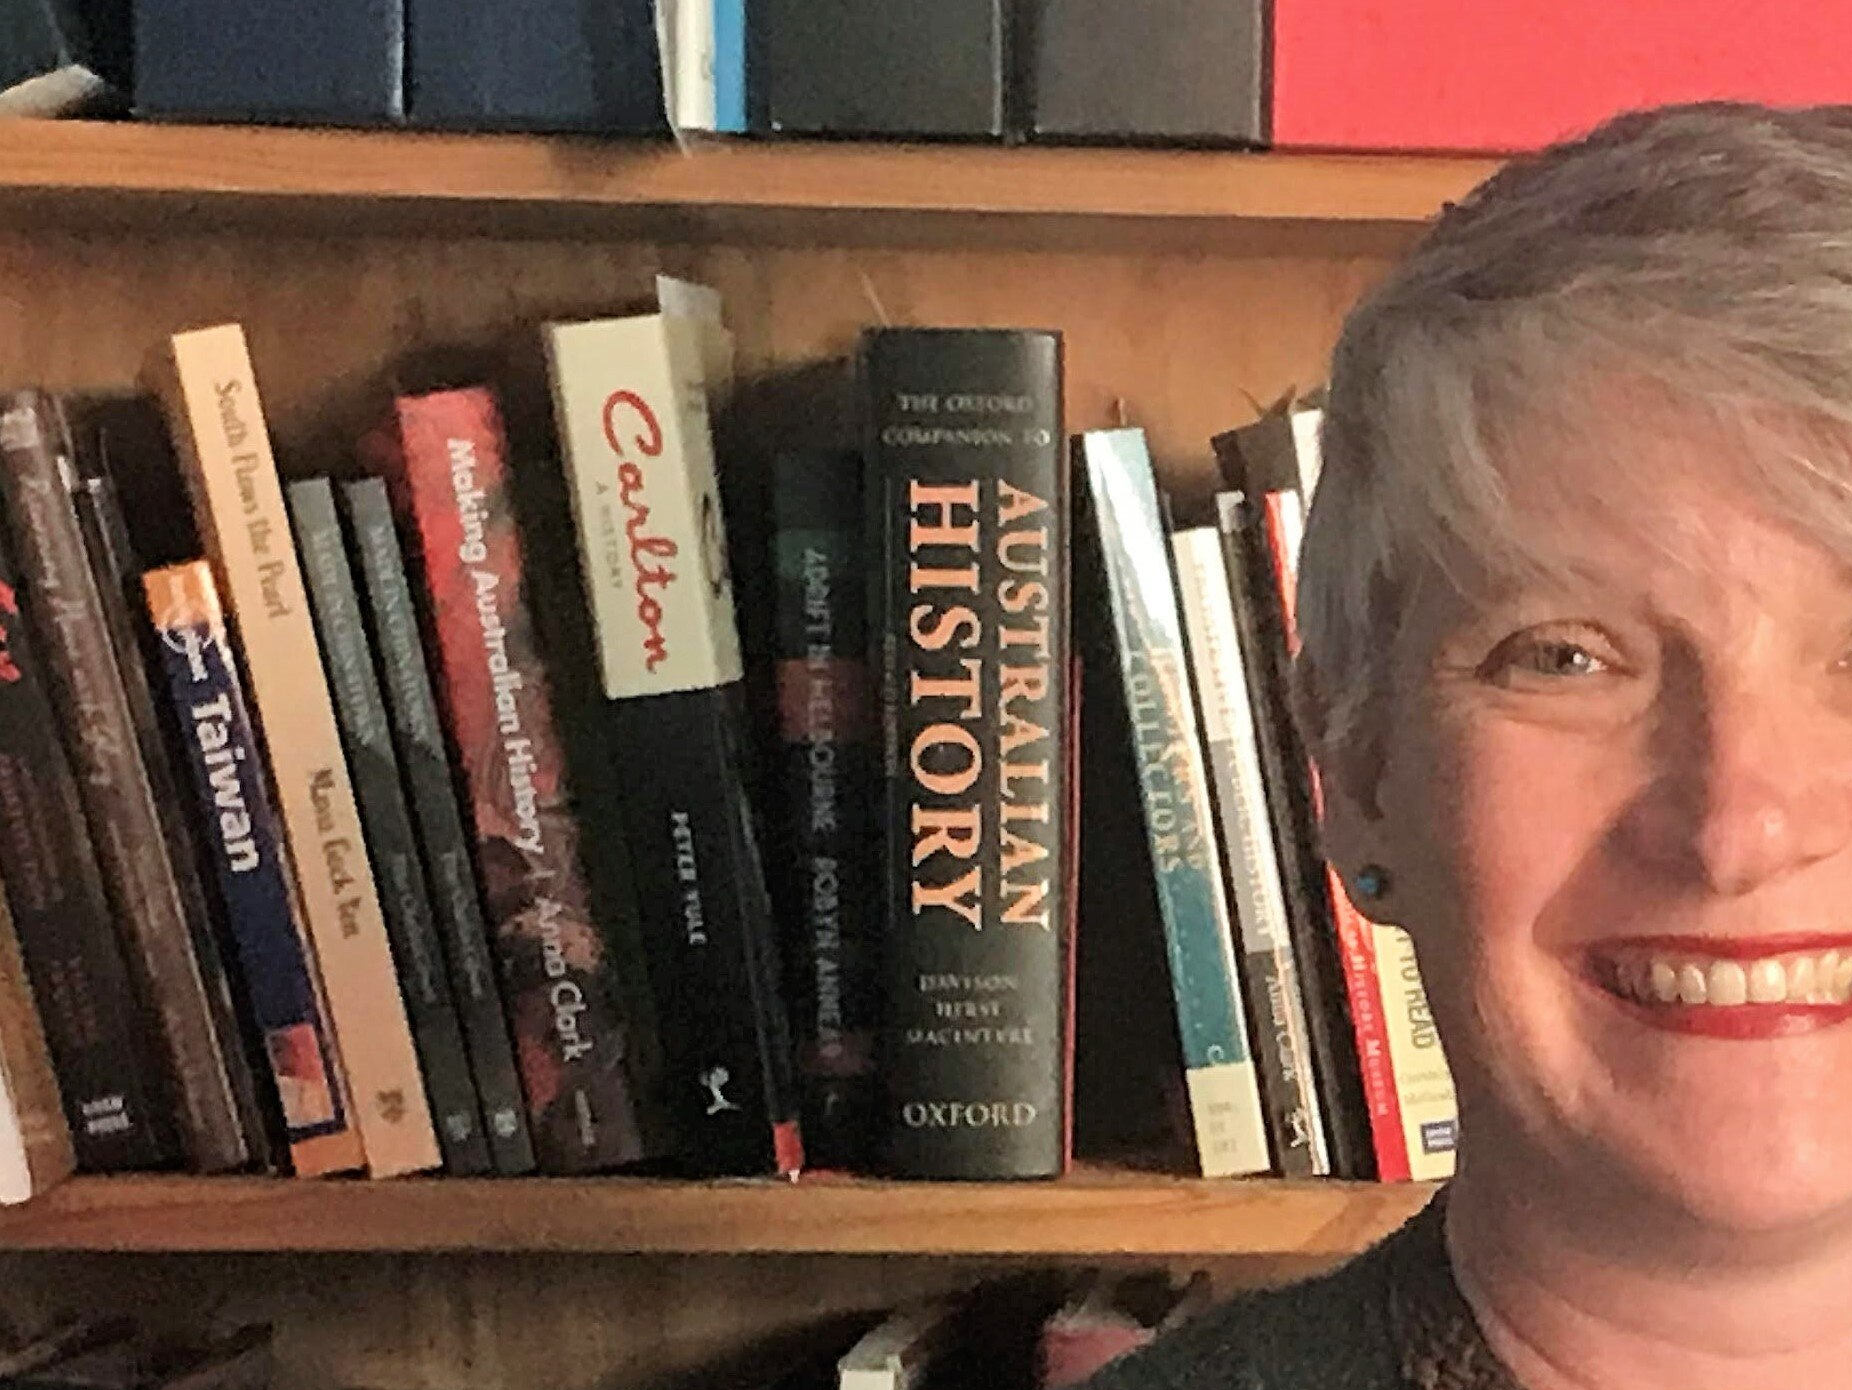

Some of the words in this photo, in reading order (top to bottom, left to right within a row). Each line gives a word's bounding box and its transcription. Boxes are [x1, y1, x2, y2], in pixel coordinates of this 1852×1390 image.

[896, 394, 938, 412] THE
[1022, 428, 1051, 446] TO
[215, 379, 247, 448] South
[231, 453, 259, 514] Flows
[247, 517, 272, 555] the
[601, 504, 623, 589] HISTORY
[602, 389, 679, 675] Carlton
[804, 548, 832, 638] ADRIFT
[447, 437, 489, 563] Making
[471, 569, 523, 734] Australian
[504, 738, 545, 853] History
[908, 477, 983, 932] HISTORY
[997, 478, 1051, 932] AUSTRALIAN
[191, 693, 260, 873] Taiwan
[808, 679, 838, 832] MELBOURNE
[1128, 650, 1182, 874] COLLECTORS
[670, 811, 698, 882] PETER
[813, 856, 840, 949] ROBYN
[534, 897, 567, 978] Anna
[551, 980, 594, 1063] Clark
[918, 973, 1019, 992] DAVISON
[902, 1101, 1037, 1127] OXFORD
[1365, 1038, 1389, 1117] MUSEUM
